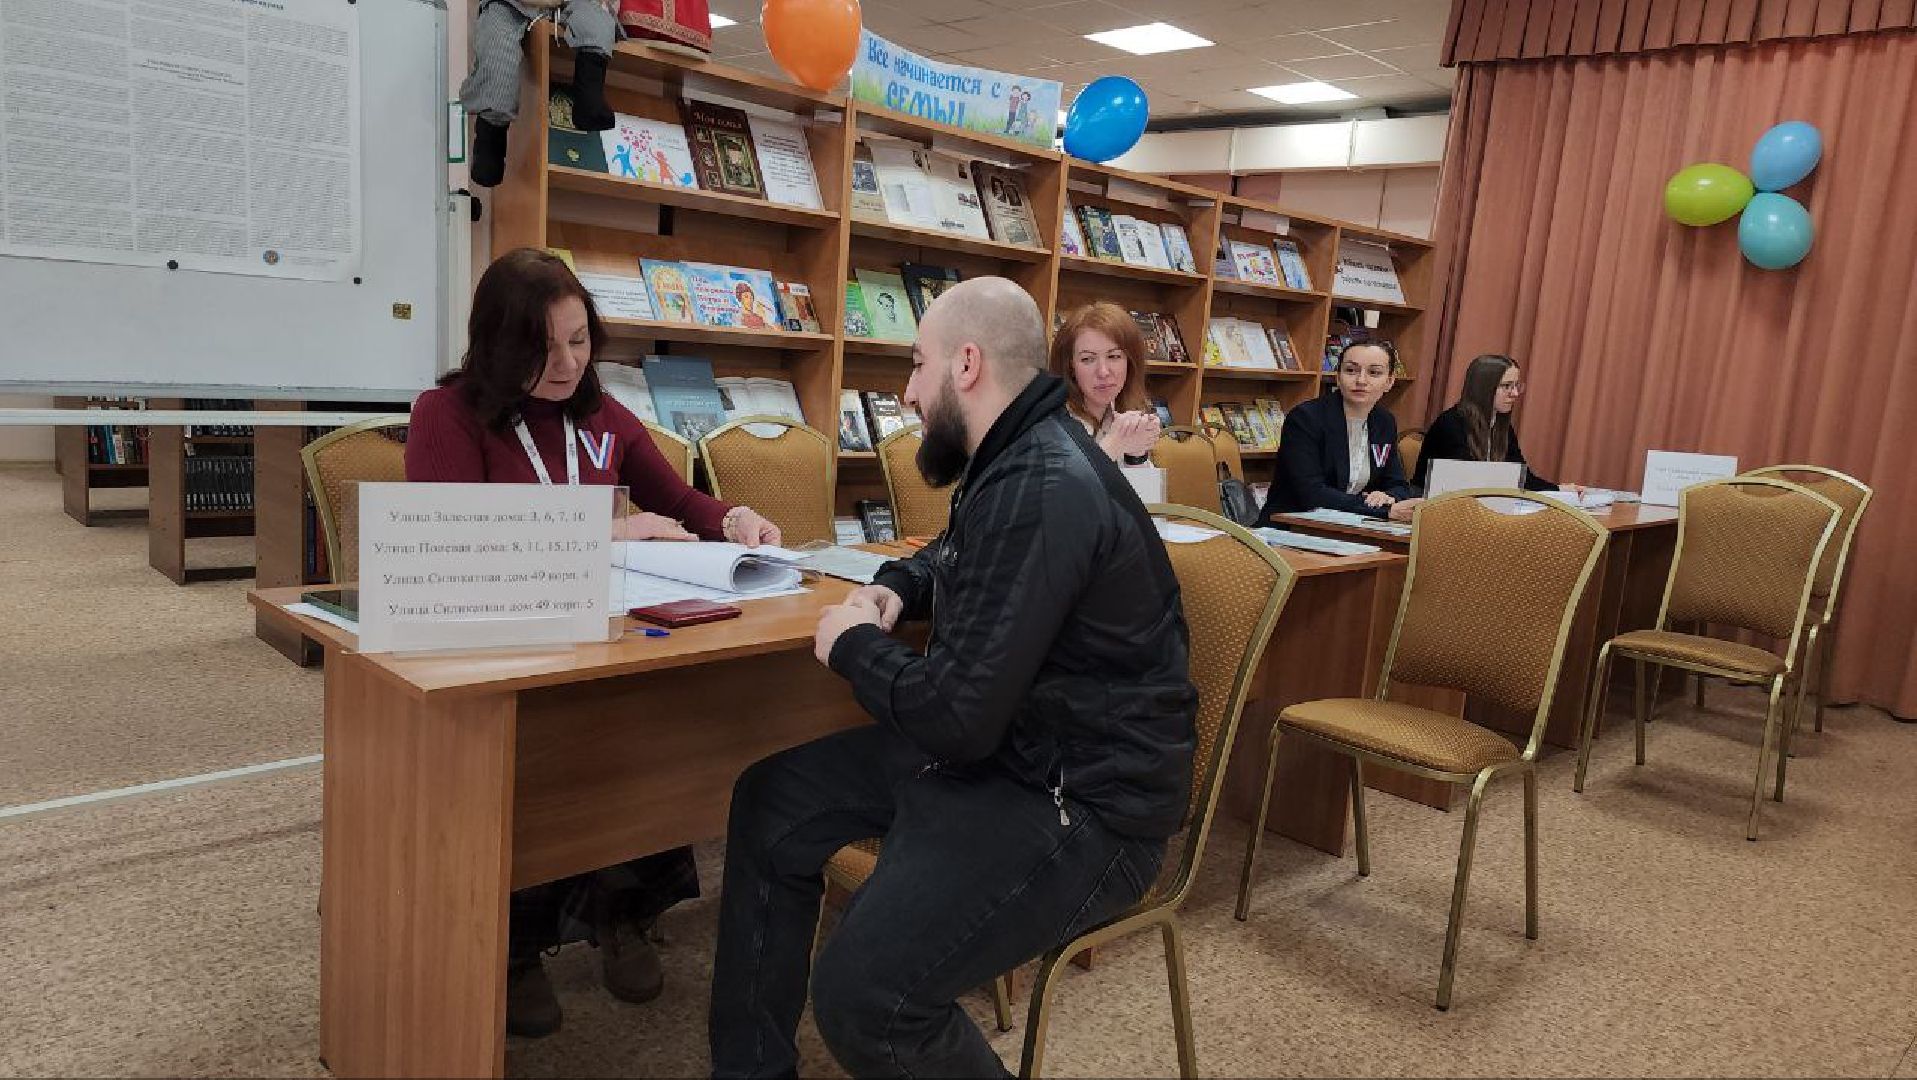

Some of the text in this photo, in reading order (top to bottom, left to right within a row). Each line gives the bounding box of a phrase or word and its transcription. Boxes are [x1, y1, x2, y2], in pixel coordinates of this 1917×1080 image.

[867, 37, 1001, 99] Все начинается с
[887, 81, 966, 128] СЕМЬИ
[389, 511, 430, 523] Улица
[433, 511, 489, 523] Залесная
[573, 511, 587, 523] 10
[374, 542, 415, 554] Улица
[419, 542, 471, 553] Полевая
[586, 540, 599, 551] 19
[383, 574, 424, 585] Улица
[427, 572, 501, 585] Силикатная
[504, 573, 528, 583] дом
[530, 570, 546, 580] 49
[389, 603, 429, 615] Улица
[433, 602, 505, 615] Силикатная
[535, 599, 550, 609] 49
[586, 598, 595, 610] 5
